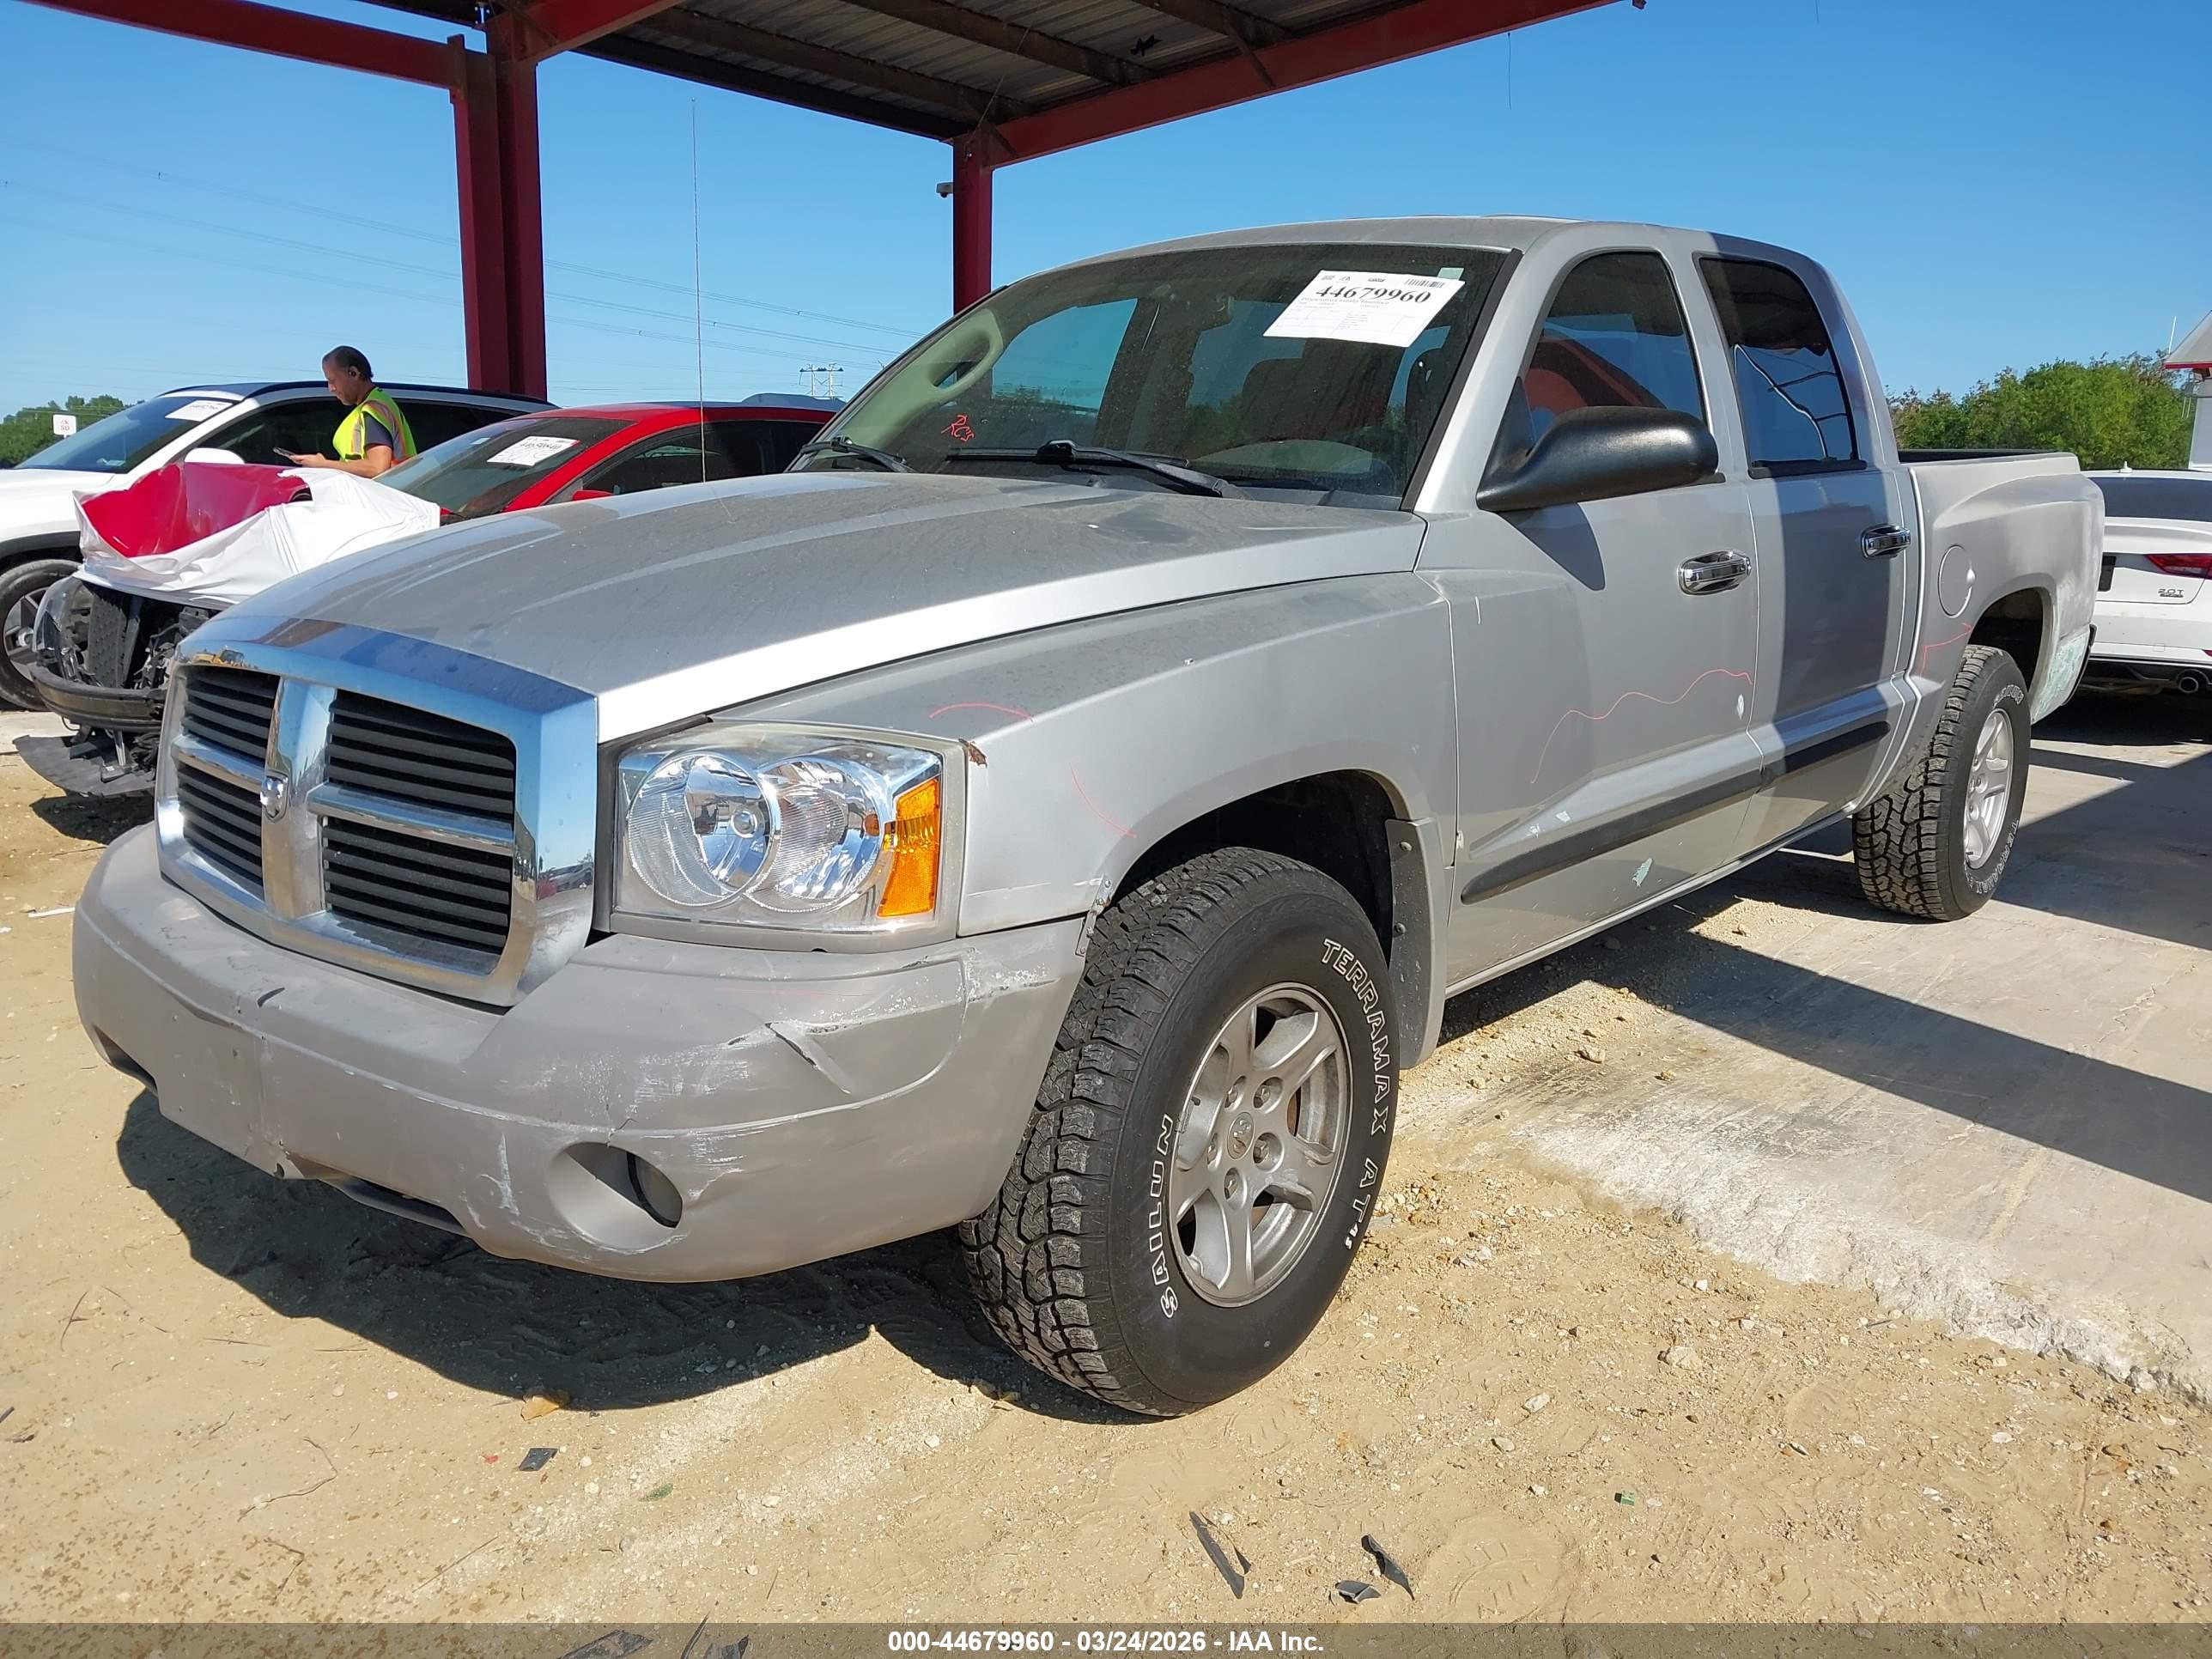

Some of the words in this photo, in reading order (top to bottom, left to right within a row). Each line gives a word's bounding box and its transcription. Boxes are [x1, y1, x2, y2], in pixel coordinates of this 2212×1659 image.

[1316, 285, 1431, 303] 44679960
[1322, 938, 1390, 1136] TERRAMAX
[1149, 1114, 1178, 1318] SAILUN
